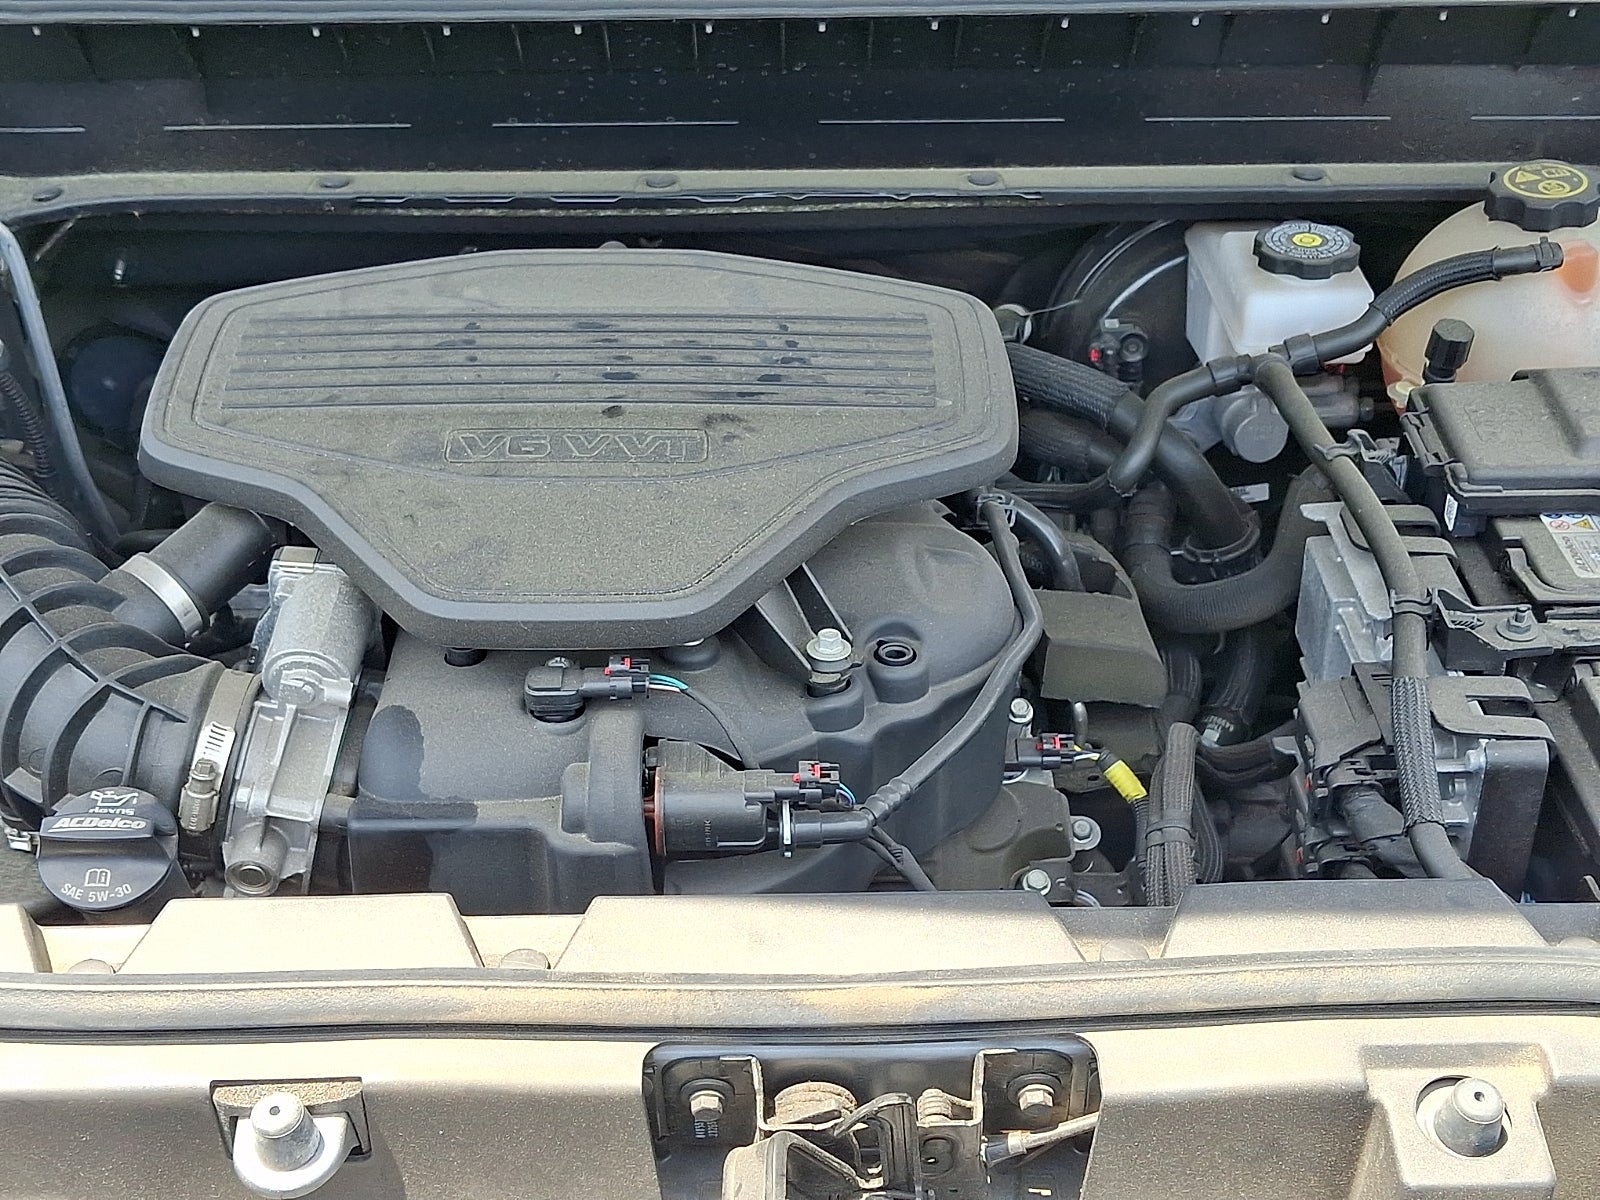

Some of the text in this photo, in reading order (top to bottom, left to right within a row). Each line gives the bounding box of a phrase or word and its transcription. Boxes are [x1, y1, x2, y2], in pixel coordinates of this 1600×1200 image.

[459, 434, 702, 462] V6 VVT
[51, 817, 146, 829] ACDelco
[61, 883, 132, 903] SAE 5W-30
